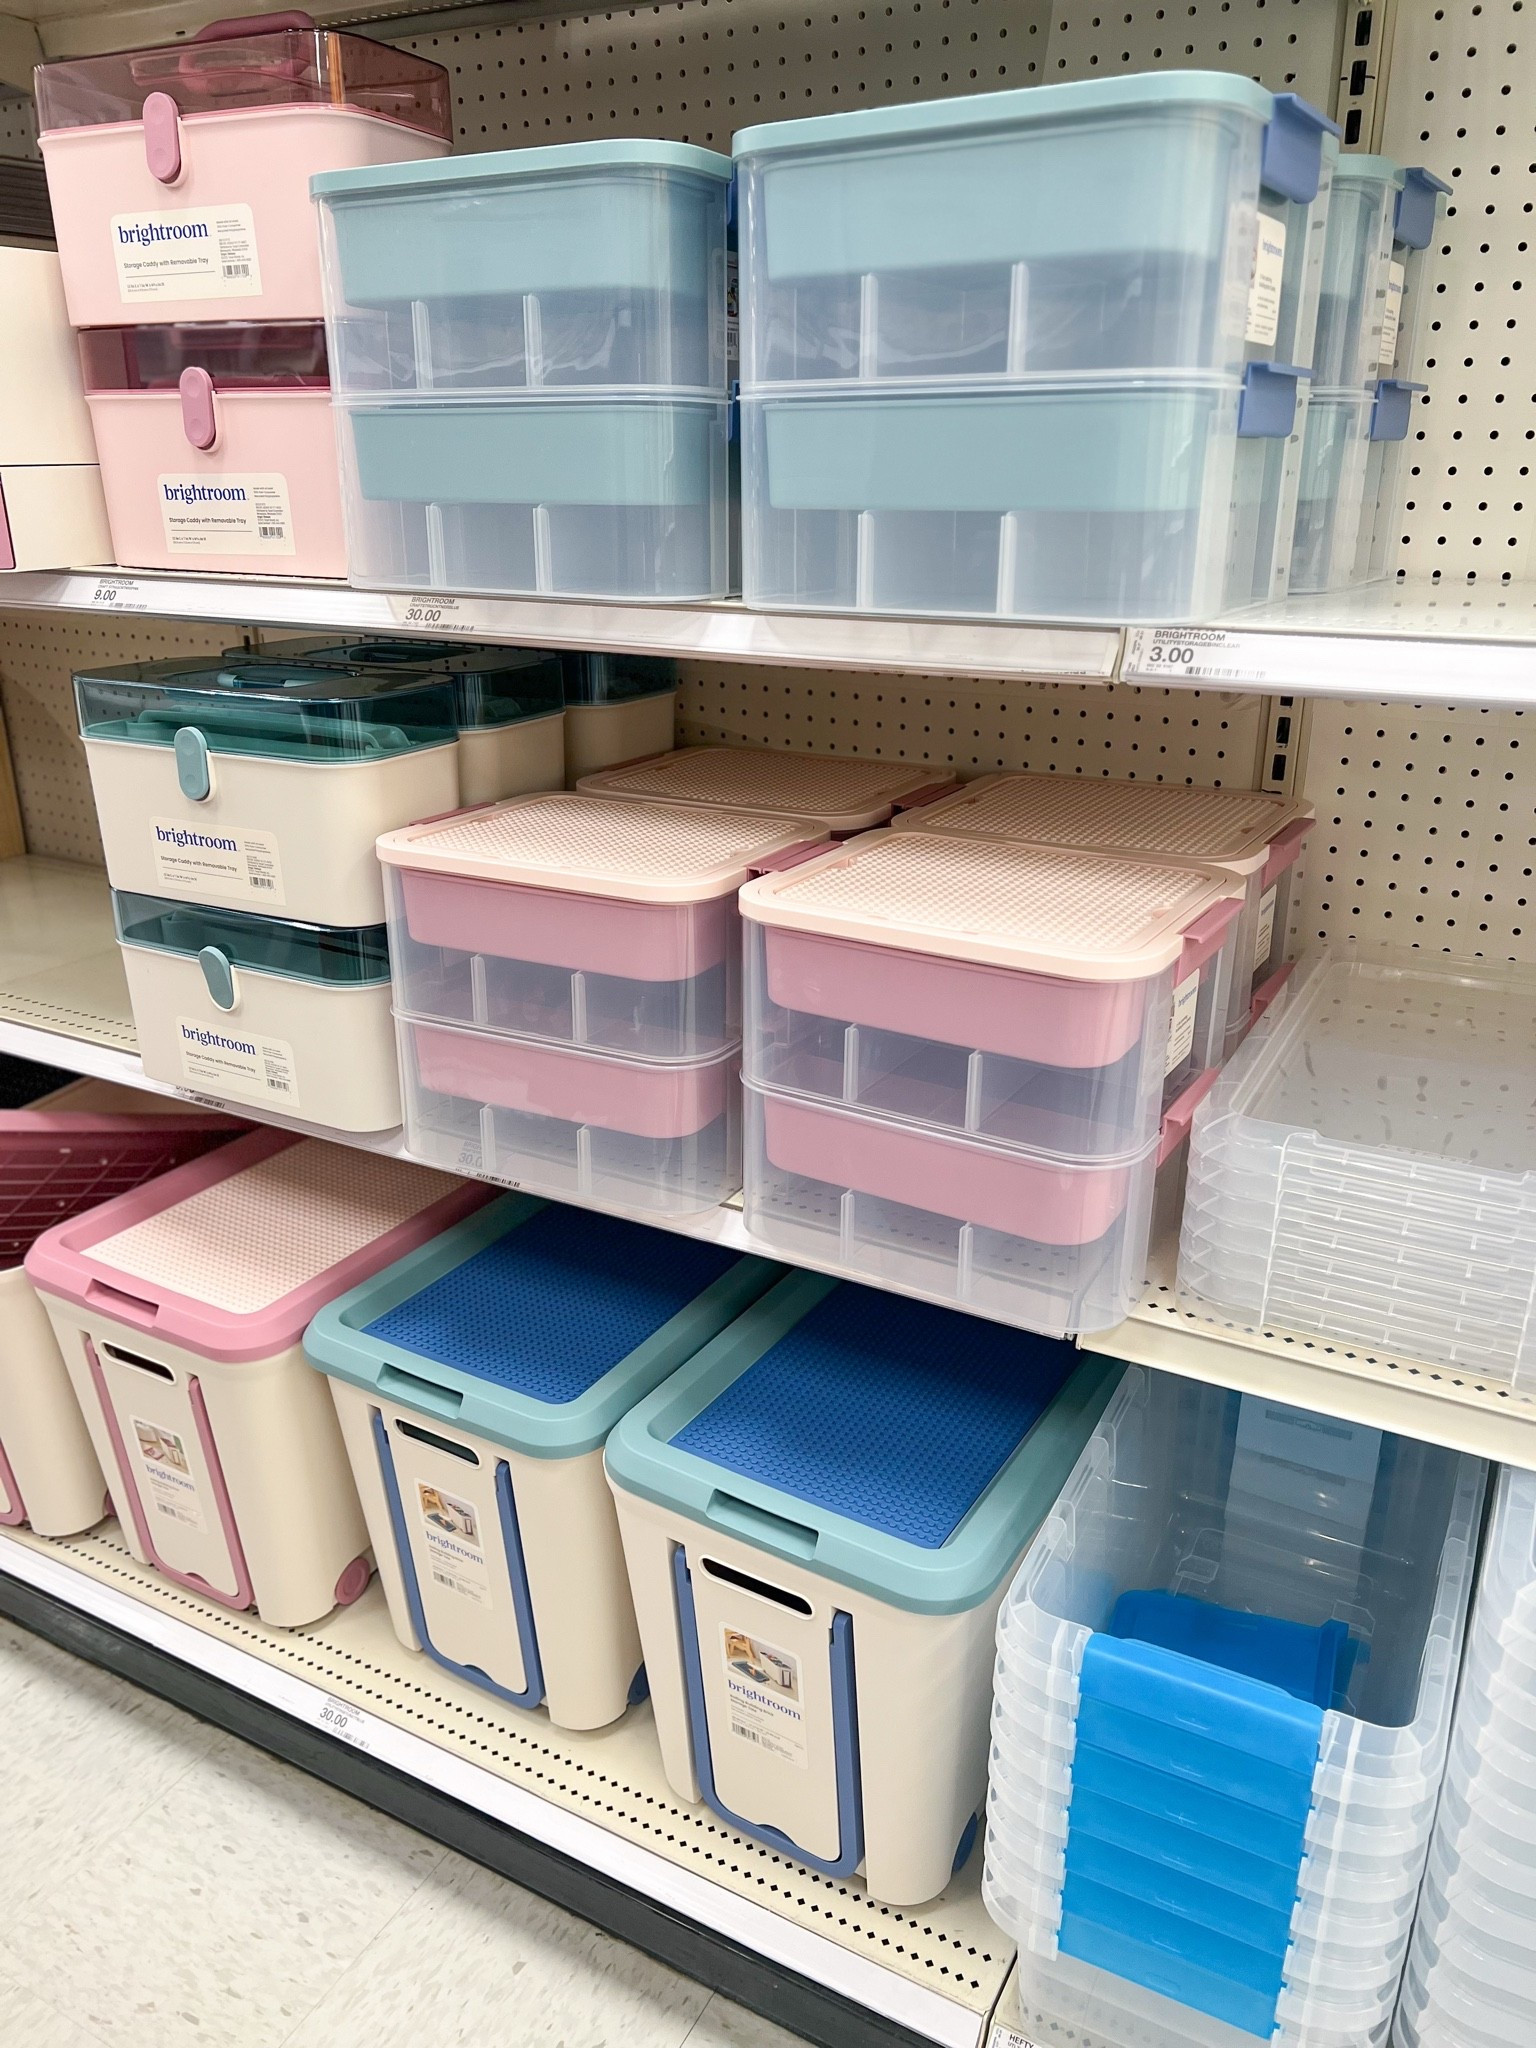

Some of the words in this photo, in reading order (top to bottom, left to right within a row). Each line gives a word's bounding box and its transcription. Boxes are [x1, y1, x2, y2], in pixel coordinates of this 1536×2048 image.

[118, 223, 209, 246] brightroom
[124, 261, 142, 270] Storage
[143, 260, 158, 269] Caddy
[170, 258, 197, 266] Removable
[198, 257, 209, 265] Tray
[163, 484, 246, 504] brightroom
[94, 589, 117, 601] 9.00
[411, 596, 456, 605] BRIGHTROOM
[405, 608, 441, 621] 30.00
[1154, 630, 1226, 642] BRIGHTROOM
[1150, 646, 1194, 664] 3.00
[155, 826, 237, 851] brightroom
[160, 856, 177, 864] Storage
[178, 858, 192, 866] Caddy
[202, 861, 227, 870] Removable
[227, 864, 237, 872] Tray
[181, 1025, 256, 1055] brightroom
[145, 1464, 195, 1492] brightroom
[426, 1531, 483, 1565] brightroom
[728, 1679, 801, 1720] brightroom
[320, 1707, 348, 1728] 30.00
[1009, 2034, 1034, 2048] HEFTY
